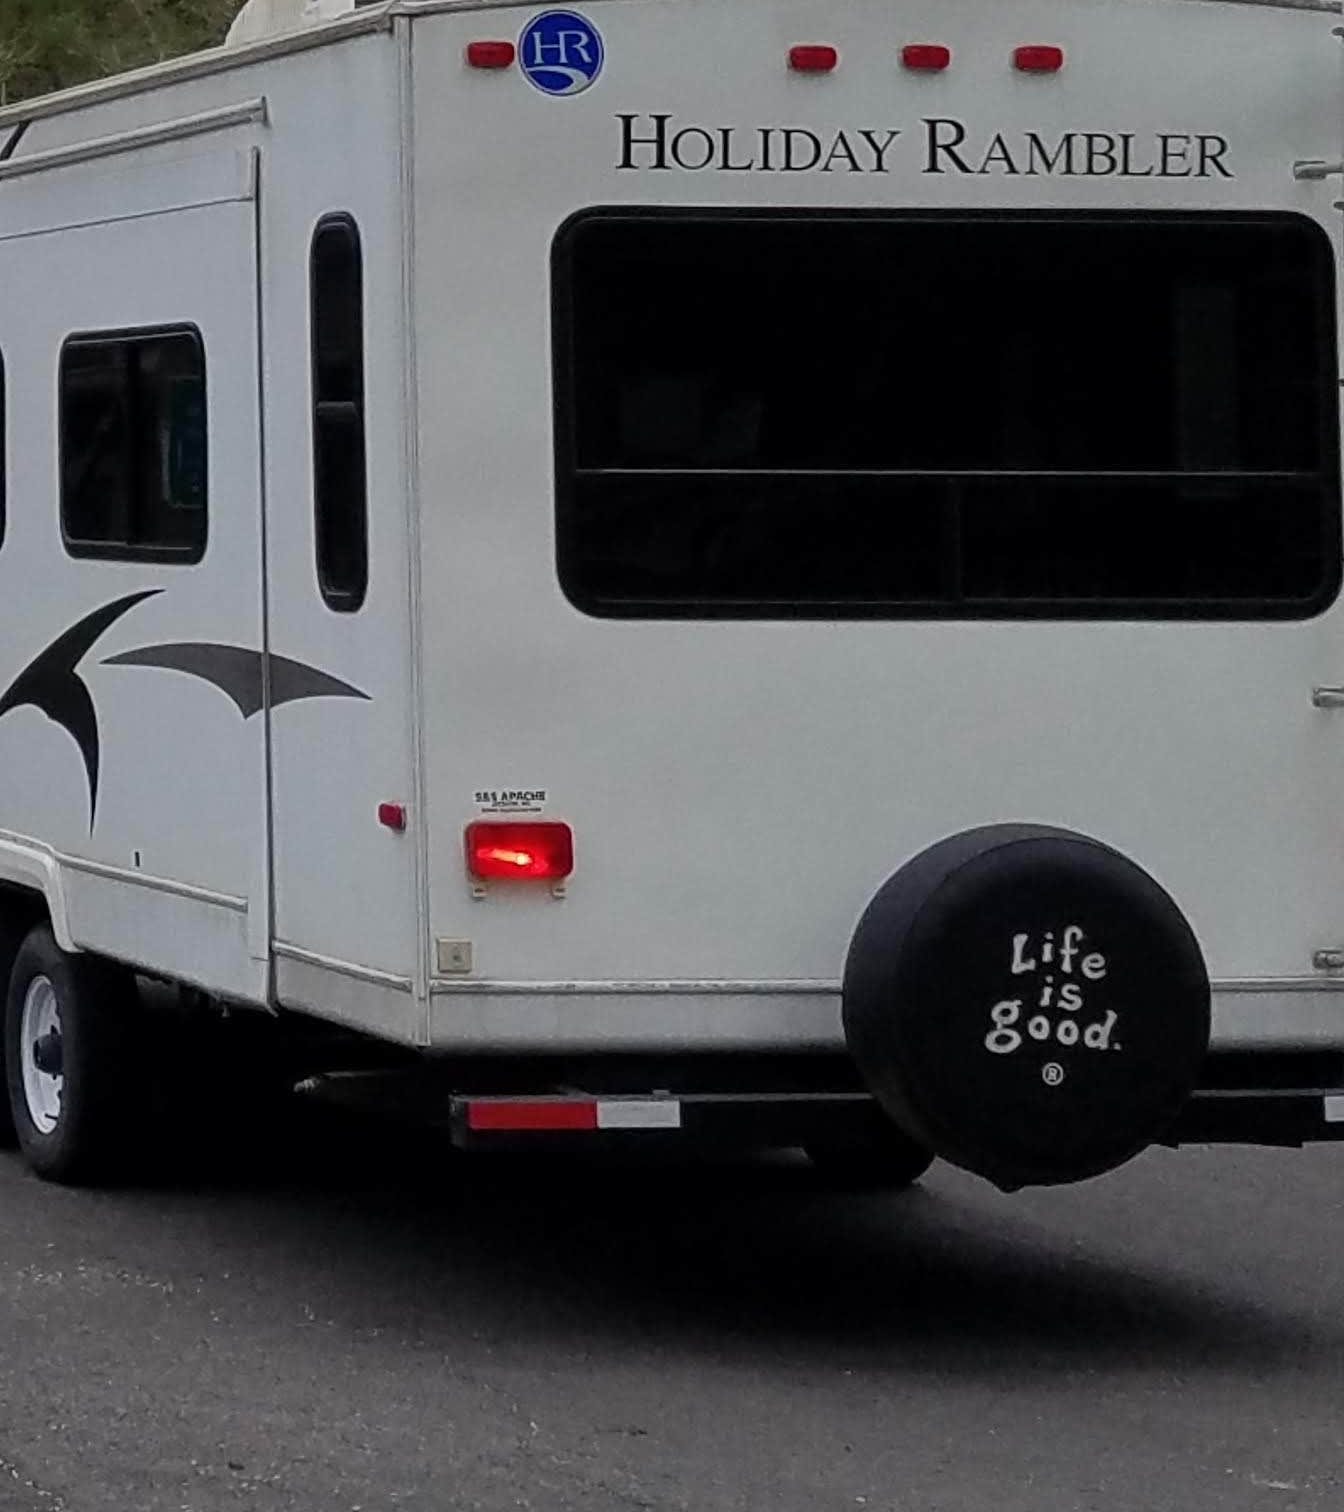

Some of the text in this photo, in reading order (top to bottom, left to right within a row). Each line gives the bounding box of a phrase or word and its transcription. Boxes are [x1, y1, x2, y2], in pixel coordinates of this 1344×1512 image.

[532, 29, 592, 64] HR
[614, 114, 1235, 178] HOLIDAY RAMBLER
[501, 791, 545, 801] APACHE
[1011, 925, 1108, 980] Life
[1040, 976, 1083, 1011] is
[985, 999, 1122, 1054] good.
